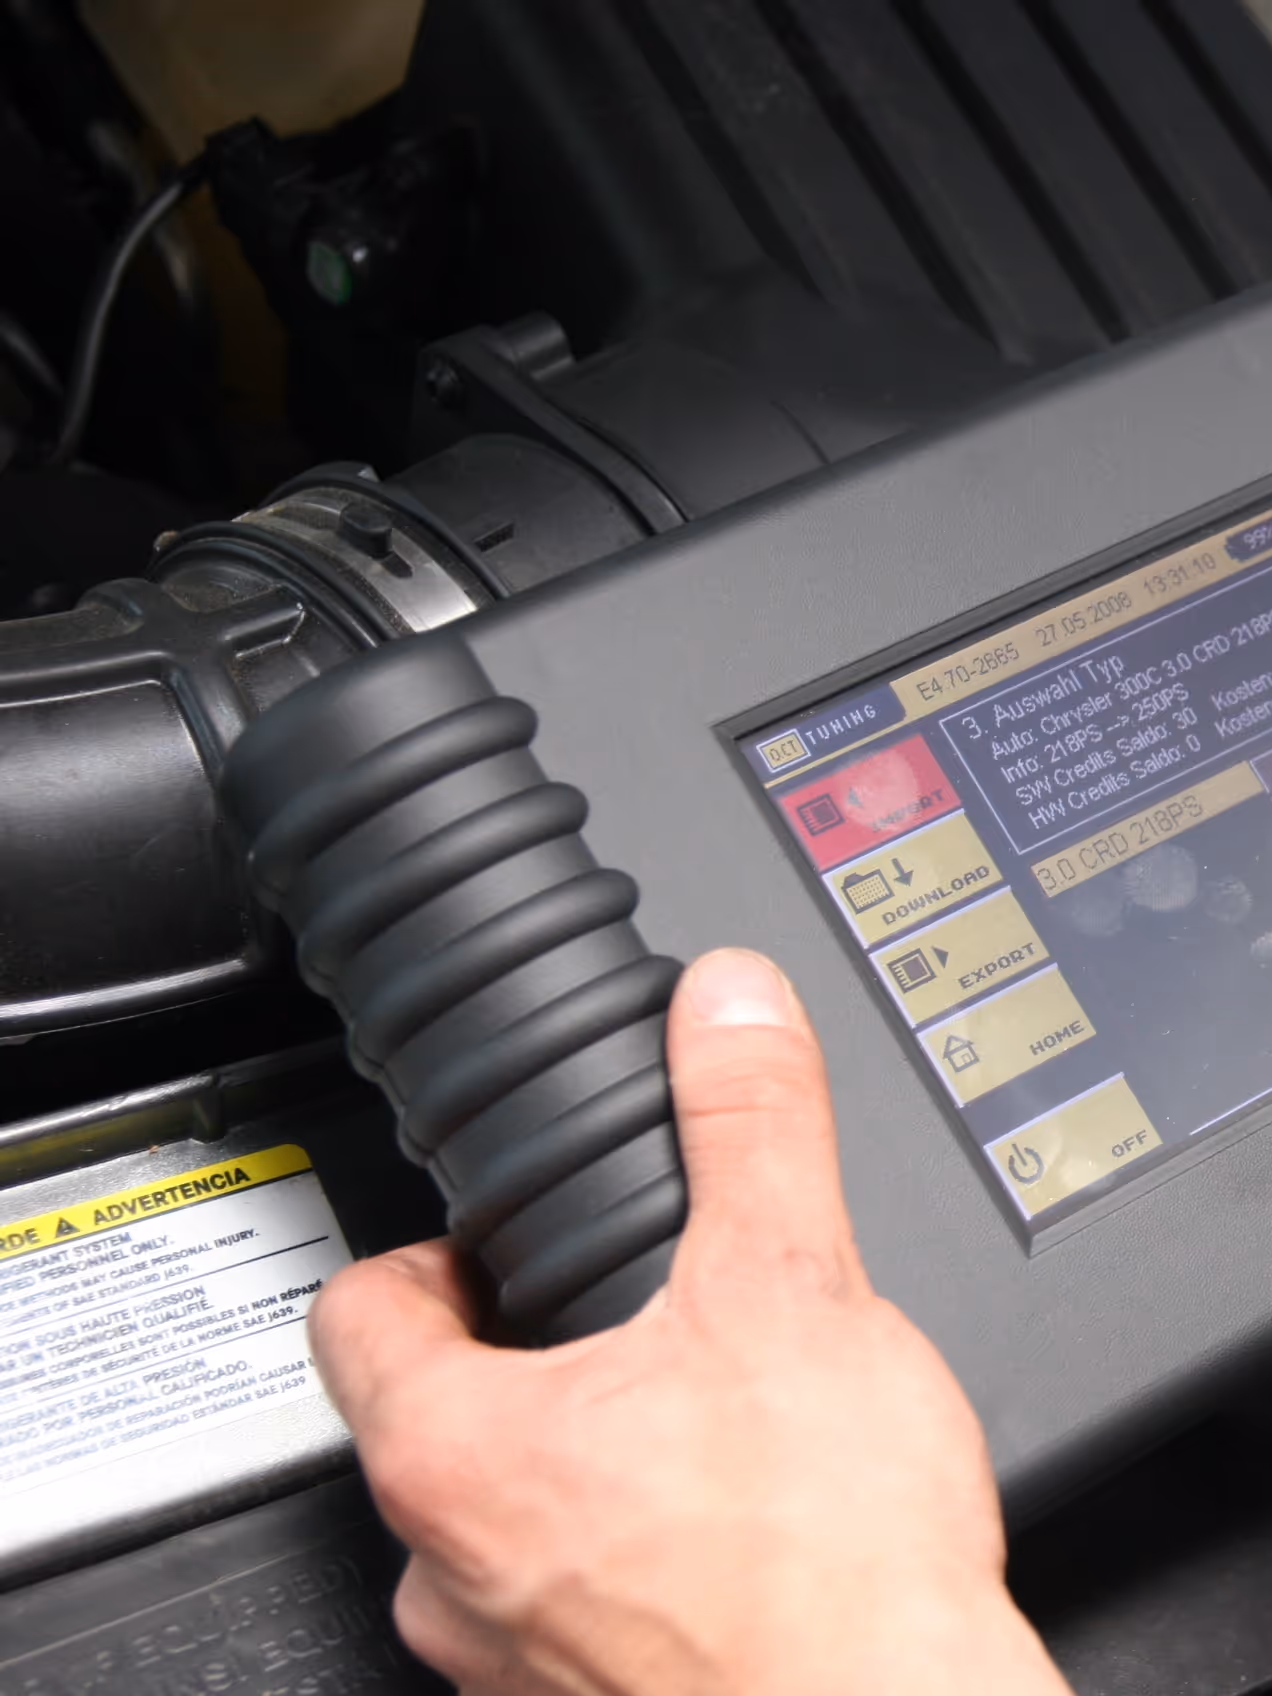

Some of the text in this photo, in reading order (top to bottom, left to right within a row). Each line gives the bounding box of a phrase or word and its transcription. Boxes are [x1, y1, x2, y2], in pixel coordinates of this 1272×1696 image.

[1034, 590, 1134, 647] 27.05.2008
[959, 649, 1130, 740] 3. Auswahl Typ
[986, 724, 1038, 760] Auto:
[1036, 688, 1115, 737] Chrysler
[1112, 665, 1164, 701] 300C
[1159, 651, 1194, 679] 3.0
[1189, 633, 1234, 664] CRD
[805, 703, 878, 745] TUNING
[999, 751, 1045, 784] Info:
[1042, 722, 1105, 763] 218PS
[1129, 681, 1191, 721] 250PS
[1013, 775, 1056, 806] SW
[1050, 745, 1118, 788] Credits
[1114, 719, 1173, 758] Saldo:
[1169, 705, 1200, 731] 30
[1027, 798, 1070, 830] HW
[1064, 767, 1132, 811] Credits
[1128, 741, 1187, 780] Saldo:
[1183, 733, 1203, 753] 0
[1035, 793, 1206, 891] 3.0 CRD 218PS
[880, 863, 992, 925] DOWNLOAD
[957, 941, 1038, 990] EXPORT
[1028, 1019, 1085, 1056] HOME
[1109, 1128, 1151, 1159] OFF
[91, 1164, 250, 1225] ADVERTENCIA
[39, 1247, 128, 1282] PERSONNEL
[72, 1231, 131, 1257] SYSTEM
[109, 1260, 148, 1279] CAUSE
[151, 1241, 211, 1267] PERSONAL
[214, 1227, 259, 1248] INJURY.
[80, 1308, 130, 1332] HAUTE
[132, 1284, 205, 1316] PRESSION
[172, 1308, 234, 1335] POSSIBLES
[251, 1294, 278, 1310] NON
[198, 1321, 239, 1341] NORME
[241, 1314, 265, 1328] SAE
[255, 1385, 278, 1398] SAE
[259, 1359, 306, 1382] CAUSAR
